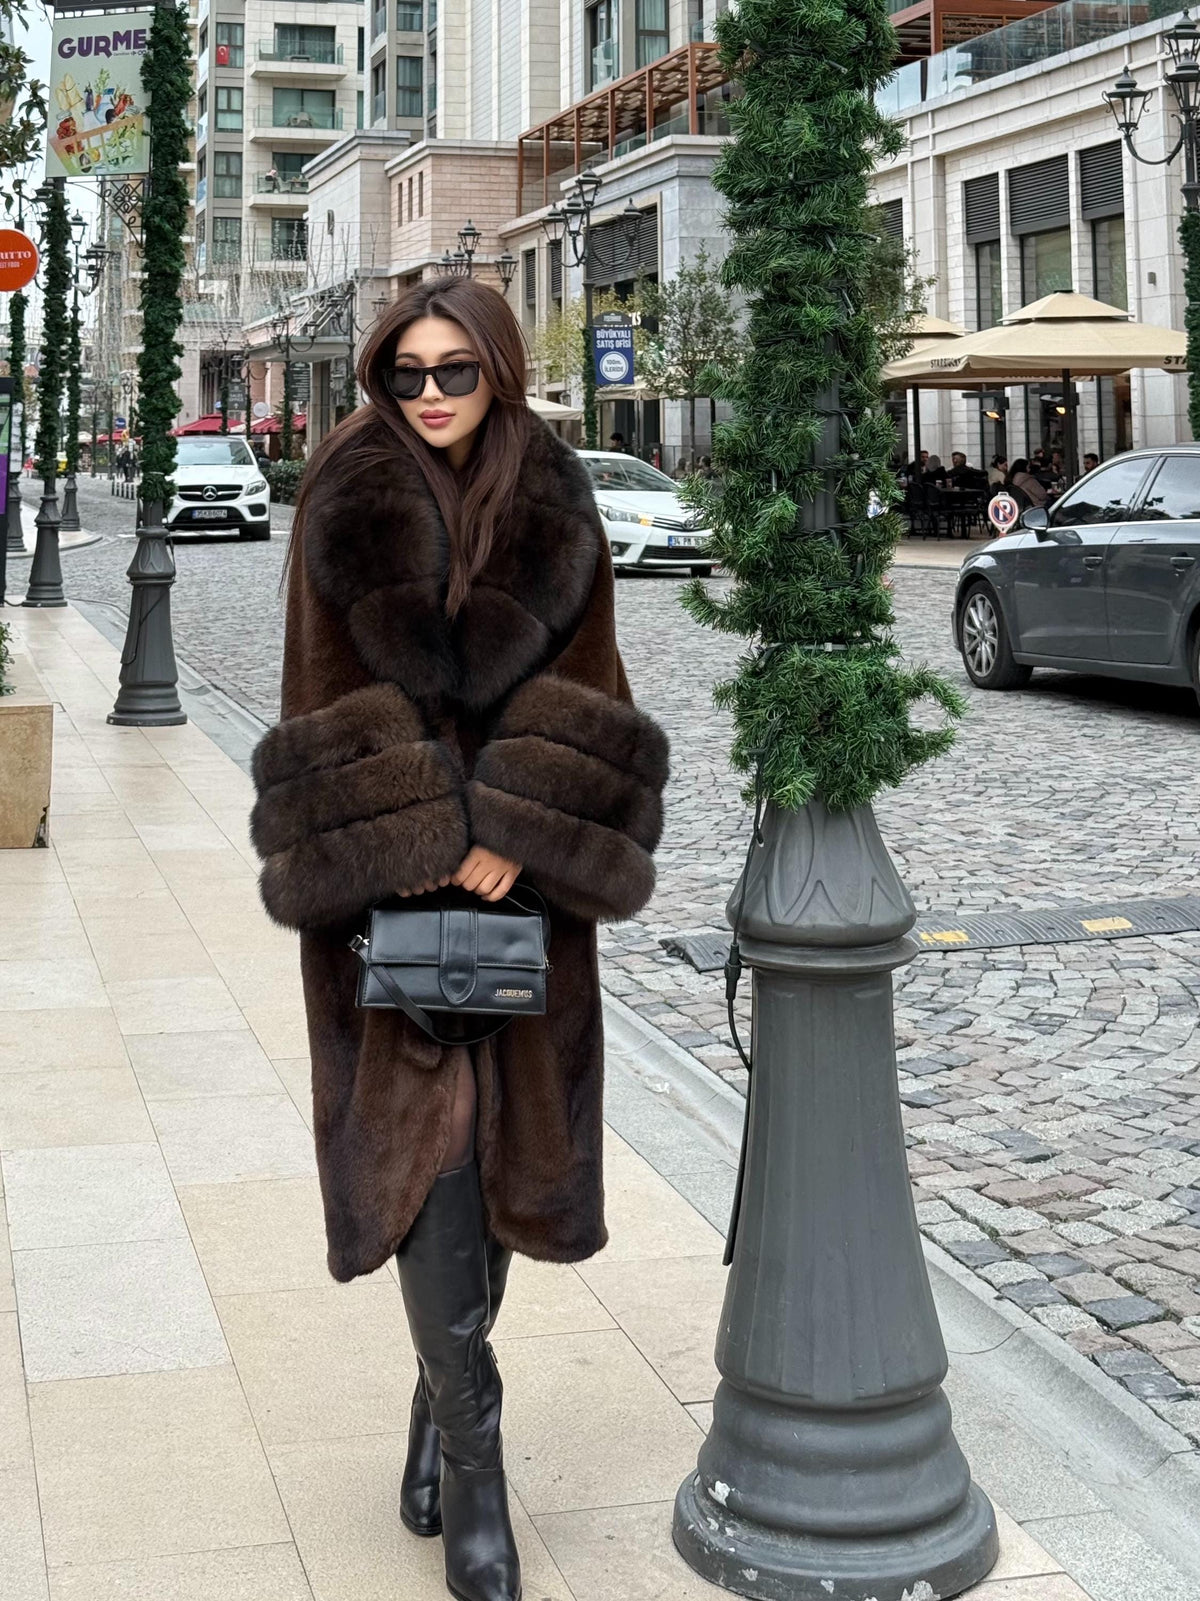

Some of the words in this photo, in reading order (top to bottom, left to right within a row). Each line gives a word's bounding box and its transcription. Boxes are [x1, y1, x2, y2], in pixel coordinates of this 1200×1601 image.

[57, 28, 147, 59] GURME
[596, 328, 631, 339] BÜYÜKYALI
[596, 339, 615, 350] SATIŞ
[615, 338, 632, 348] OFİSİ
[673, 536, 681, 546] 34
